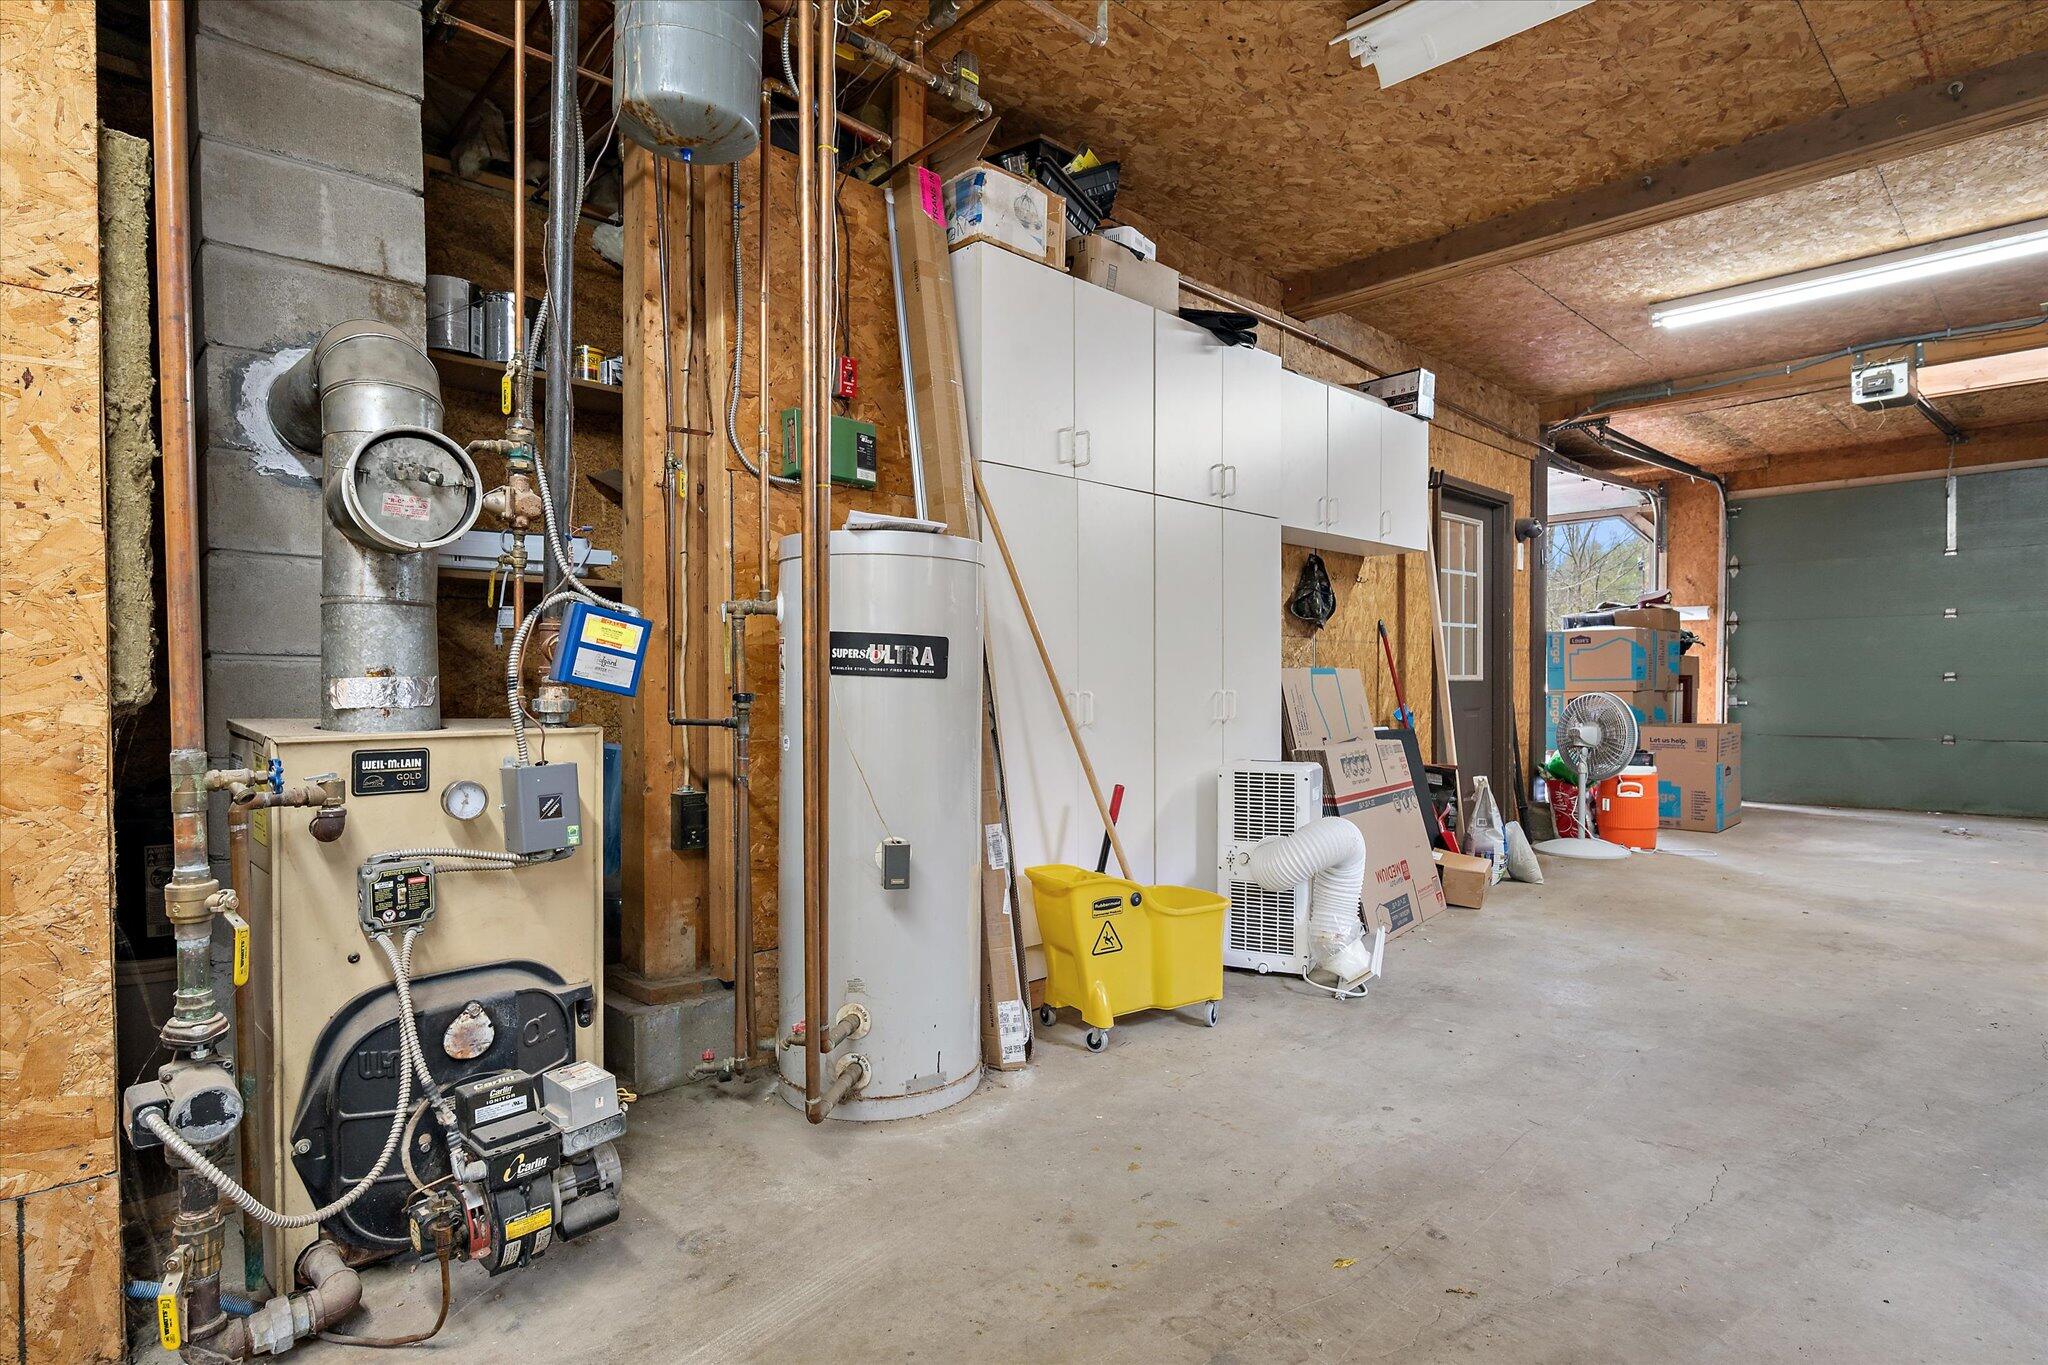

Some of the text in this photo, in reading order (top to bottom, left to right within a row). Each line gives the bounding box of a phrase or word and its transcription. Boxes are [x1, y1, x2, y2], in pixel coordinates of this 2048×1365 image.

[869, 643, 935, 667] ULTRA
[1551, 634, 1562, 665] large
[1649, 736, 1660, 744] Let
[1671, 737, 1688, 746] help.
[396, 772, 422, 781] GOLD
[1375, 862, 1401, 884] MEDIUM
[473, 1075, 515, 1091] Carlin
[489, 1085, 513, 1098] Carlin
[485, 1093, 516, 1105] IGNITOR
[517, 1156, 549, 1174] Carlin
[162, 1310, 171, 1336] WATTS
